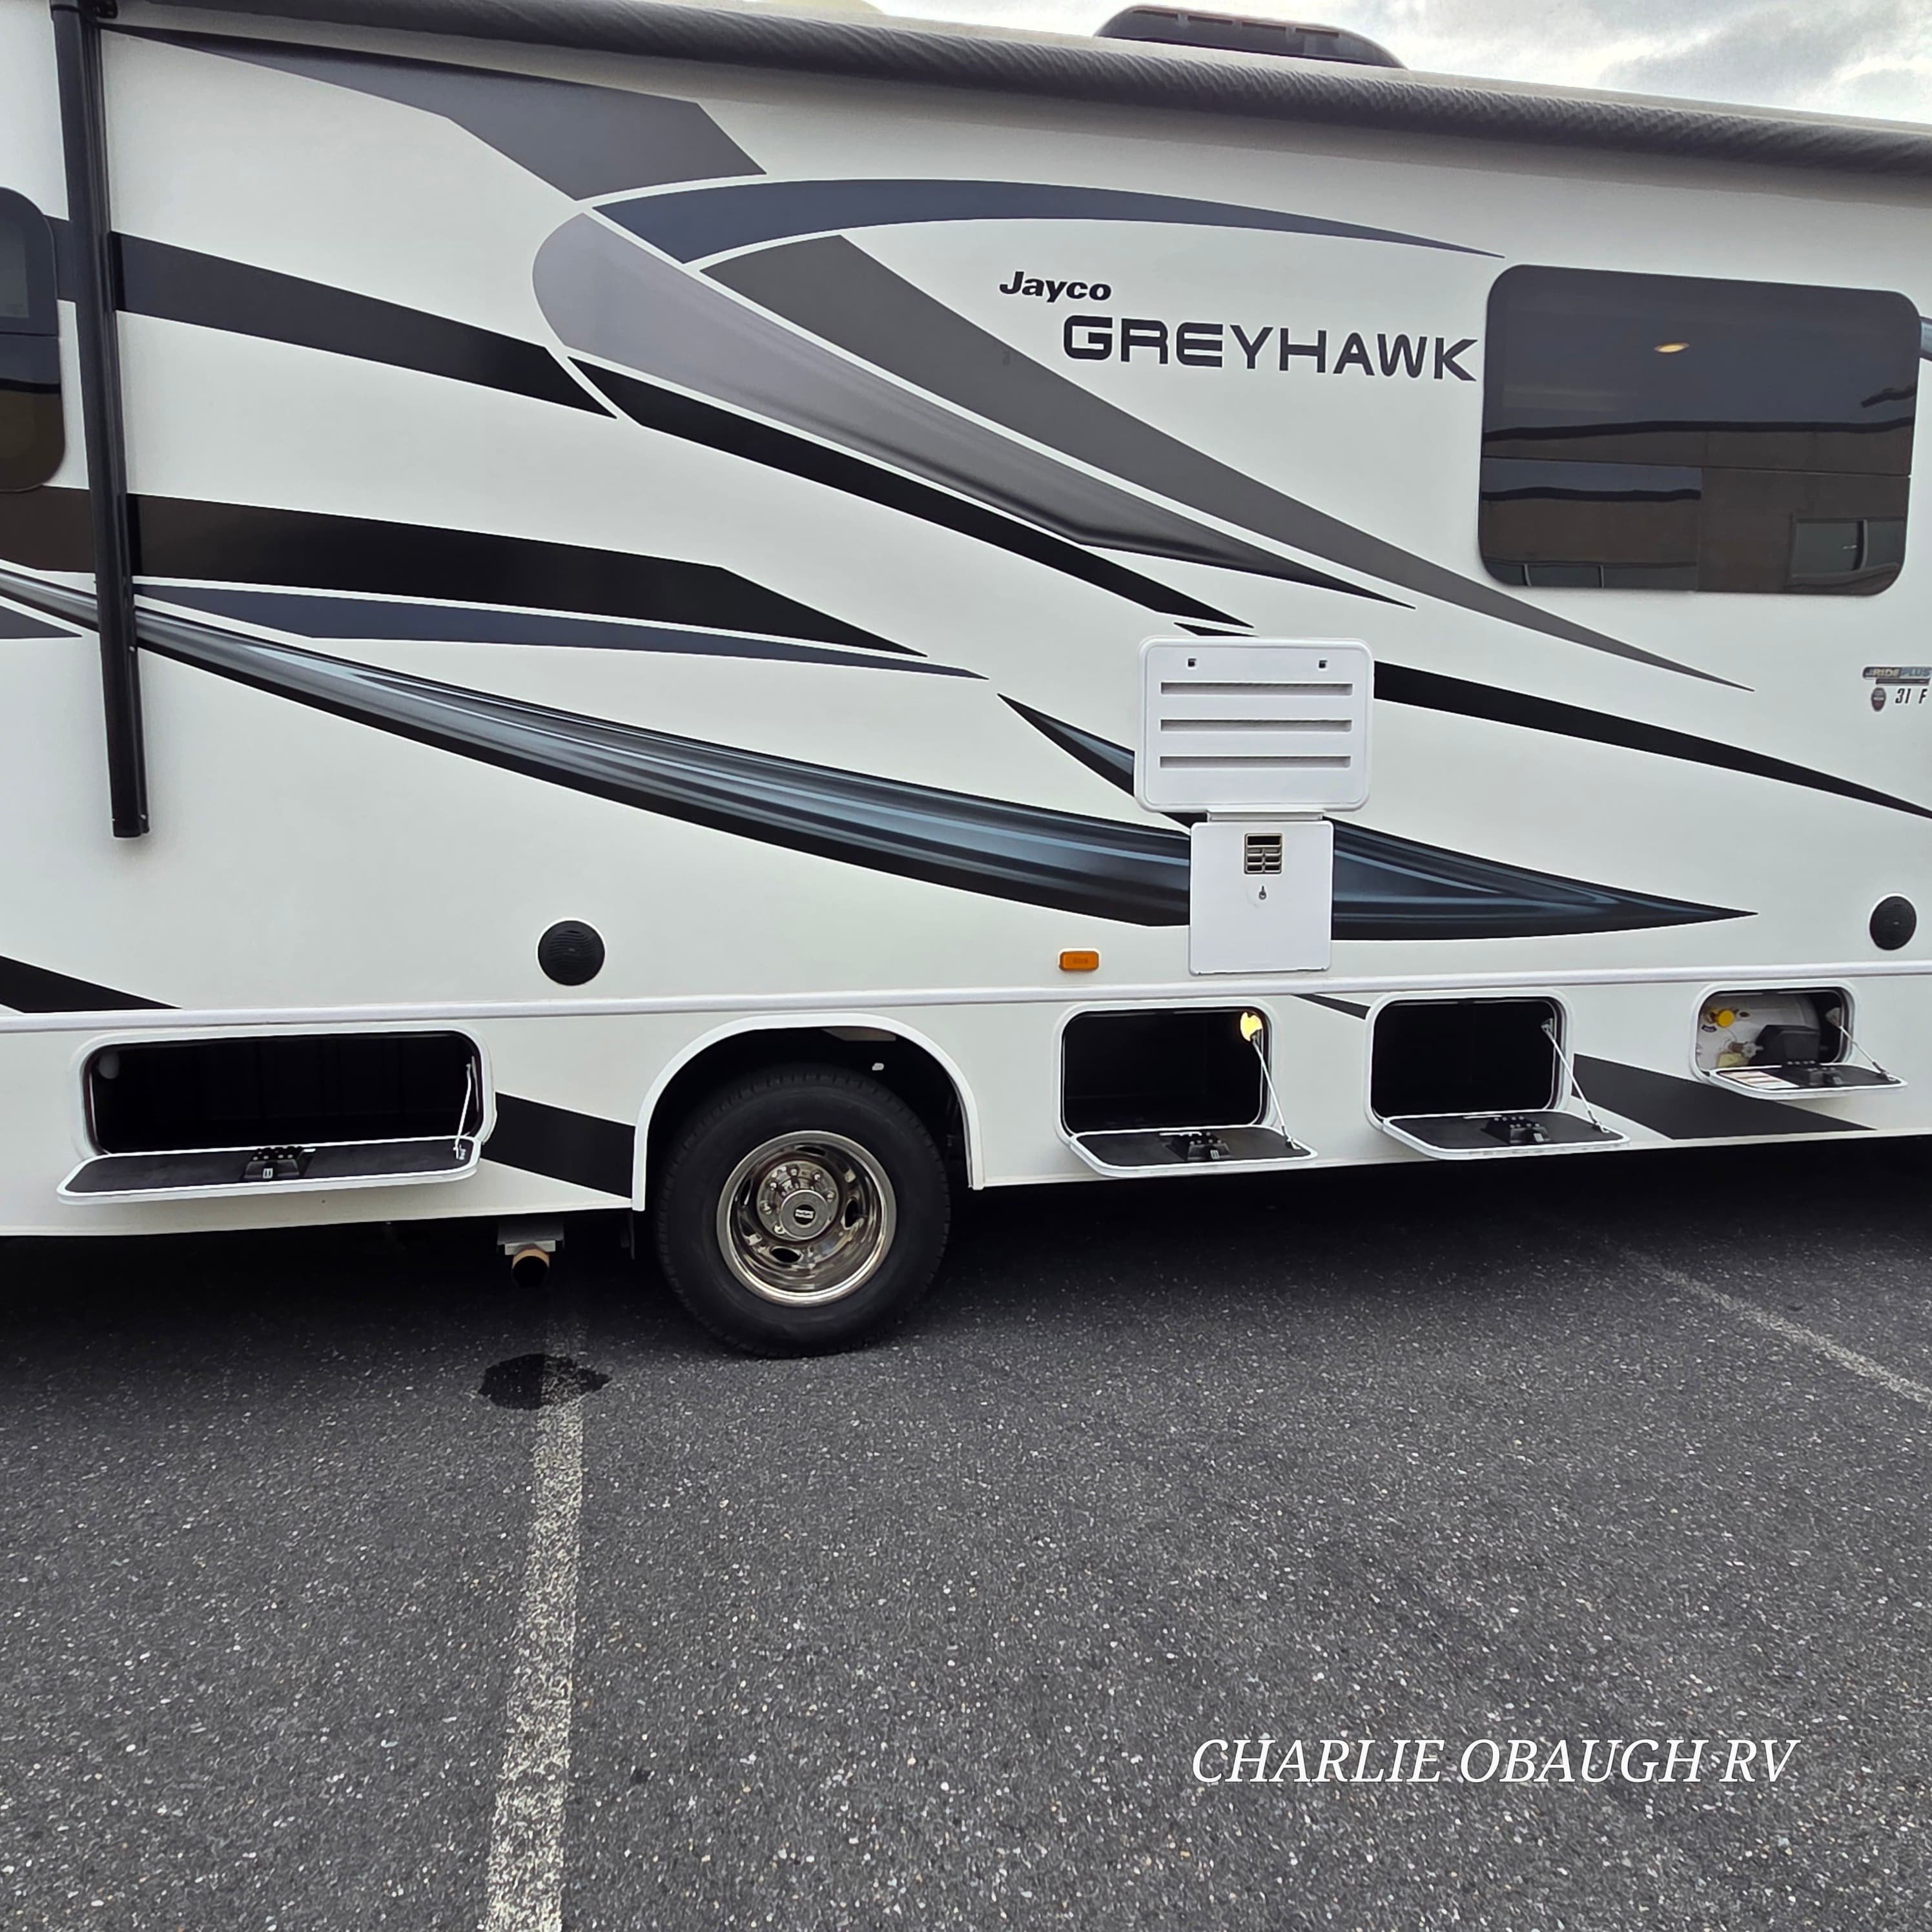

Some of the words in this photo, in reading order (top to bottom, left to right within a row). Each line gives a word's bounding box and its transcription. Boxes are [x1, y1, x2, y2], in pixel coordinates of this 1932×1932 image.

[999, 271, 1111, 303] Jayco
[1063, 314, 1478, 382] GREYHAWK
[1895, 688, 1911, 704] 31
